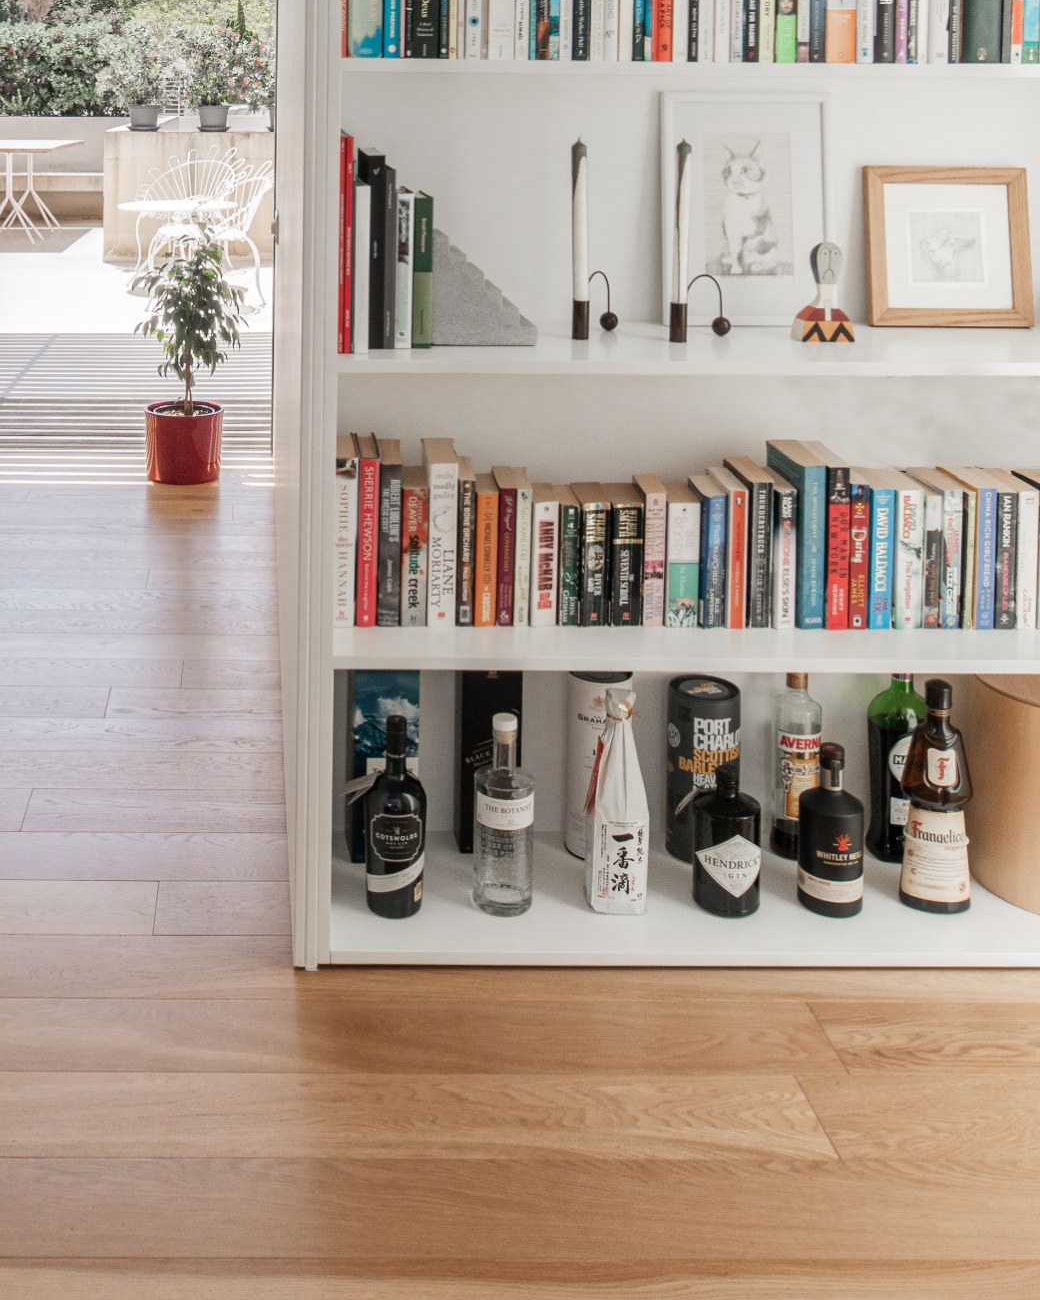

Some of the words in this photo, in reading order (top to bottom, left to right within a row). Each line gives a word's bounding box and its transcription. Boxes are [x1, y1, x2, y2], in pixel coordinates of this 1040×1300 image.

[862, 10, 870, 21] THE
[748, 23, 756, 46] MADMEN
[862, 24, 870, 43] WIND
[364, 467, 374, 509] SHERRIE
[390, 479, 401, 505] ROBERT
[339, 485, 349, 533] SOPHIE
[409, 496, 418, 532] DEAVER
[903, 495, 911, 539] BALDACCI
[910, 504, 918, 531] DAVID
[984, 492, 992, 517] CHINA
[1004, 496, 1012, 512] IAN
[389, 507, 400, 542] LUDLUM'S
[483, 522, 491, 545] MICHAEL
[539, 521, 554, 549] ANDY
[586, 513, 596, 543] SMITH
[595, 513, 605, 541] WILBUR
[619, 510, 629, 537] SMITH
[757, 490, 766, 554] THUNDERSTRUCK
[831, 516, 839, 538] NEW
[839, 512, 848, 532] OUR
[877, 507, 890, 538] DAVID
[984, 519, 992, 538] RICH
[1002, 514, 1011, 547] RANKIN
[362, 513, 373, 561] HEWSON
[462, 528, 470, 562] ORCHARD
[646, 524, 655, 557] BERRY
[655, 523, 665, 555] STEVE
[674, 516, 687, 559] Bryson
[782, 520, 791, 566] SOMEONE
[839, 539, 848, 560] MAN
[409, 534, 421, 575] solitude
[620, 550, 629, 581] SEVENTH
[830, 546, 839, 574] YORK
[875, 541, 888, 592] BALDACCI
[905, 560, 913, 572] The
[983, 540, 991, 588] GIRLFRIEND
[337, 551, 348, 607] HANNAH
[430, 537, 443, 609] MORIARTY
[442, 550, 454, 595] LIANE
[538, 554, 554, 591] McNAB
[593, 573, 602, 596] RIVER
[756, 569, 764, 585] Erik
[782, 568, 790, 595] ELSE'S
[408, 578, 420, 610] creek
[619, 582, 629, 606] SCROLL
[645, 582, 654, 621] VENDETTA
[857, 574, 865, 608] ELLIOTT
[873, 596, 882, 613] FIX
[904, 574, 913, 609] Forgotten
[562, 590, 570, 623] GRISHAM
[655, 595, 663, 617] PARIS
[781, 597, 790, 618] SKIN
[693, 717, 732, 735] PORT
[693, 730, 741, 751] CHARLO
[465, 750, 493, 765] BLACK
[693, 773, 717, 784] HEAV
[485, 804, 501, 813] THE
[501, 804, 533, 815] BOTANIST
[375, 831, 419, 842] COTSWOLDS
[911, 820, 966, 844] Frangelico
[704, 854, 761, 869] HENDRICK
[816, 850, 848, 862] WHITLEY
[848, 852, 863, 861] NEILL
